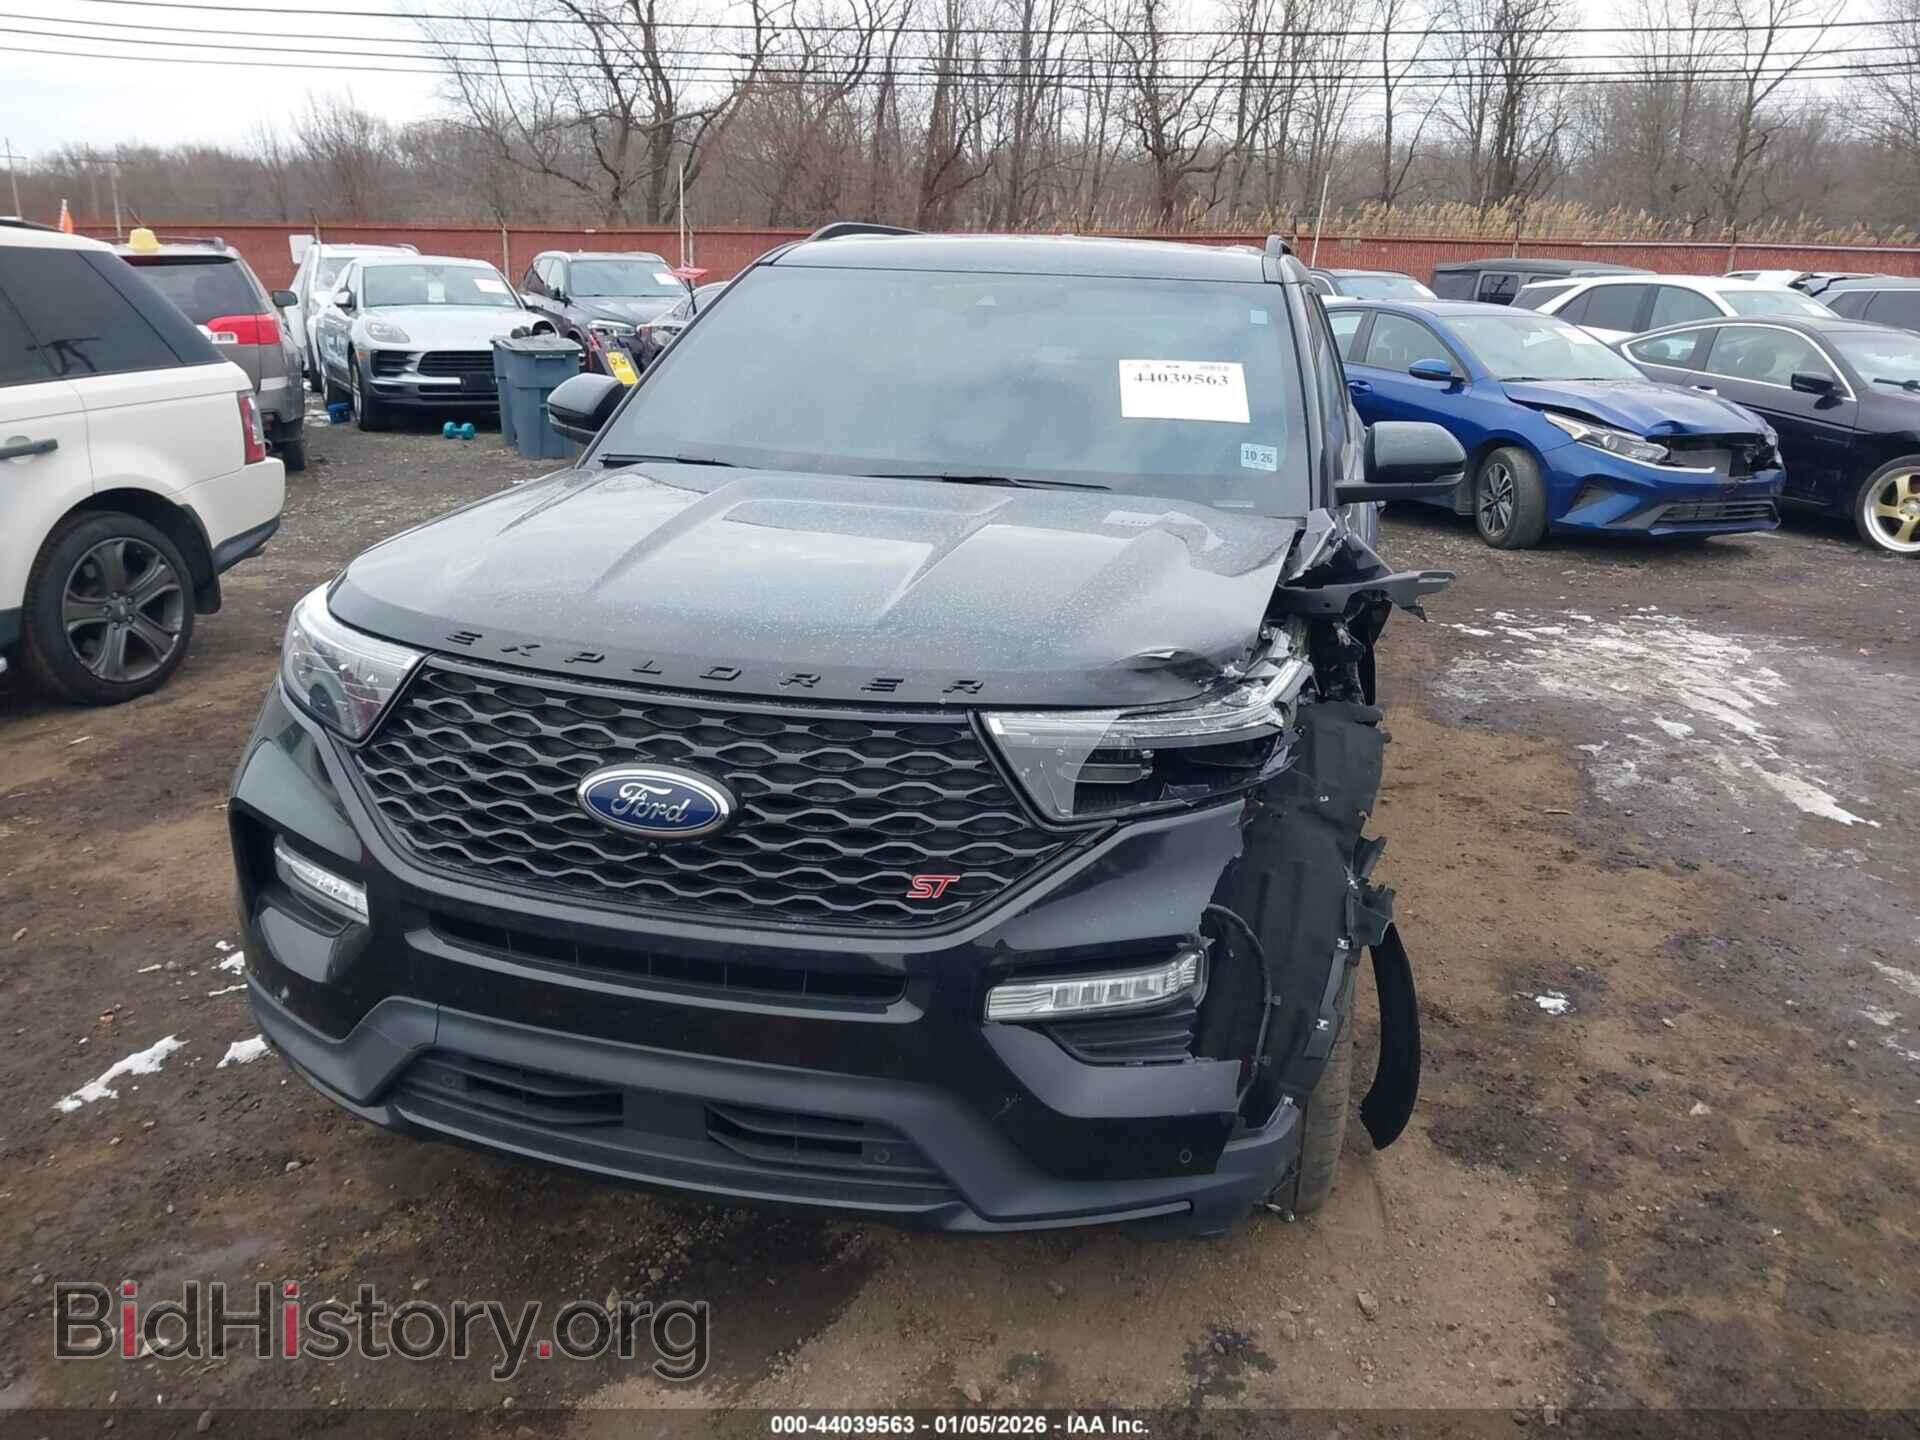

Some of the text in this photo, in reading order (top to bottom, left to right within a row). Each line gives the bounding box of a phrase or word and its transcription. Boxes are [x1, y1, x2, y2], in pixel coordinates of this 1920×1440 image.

[1133, 372, 1229, 386] 44039563
[445, 630, 984, 695] EXPLORER
[610, 782, 690, 823] Ford
[905, 873, 961, 899] ST
